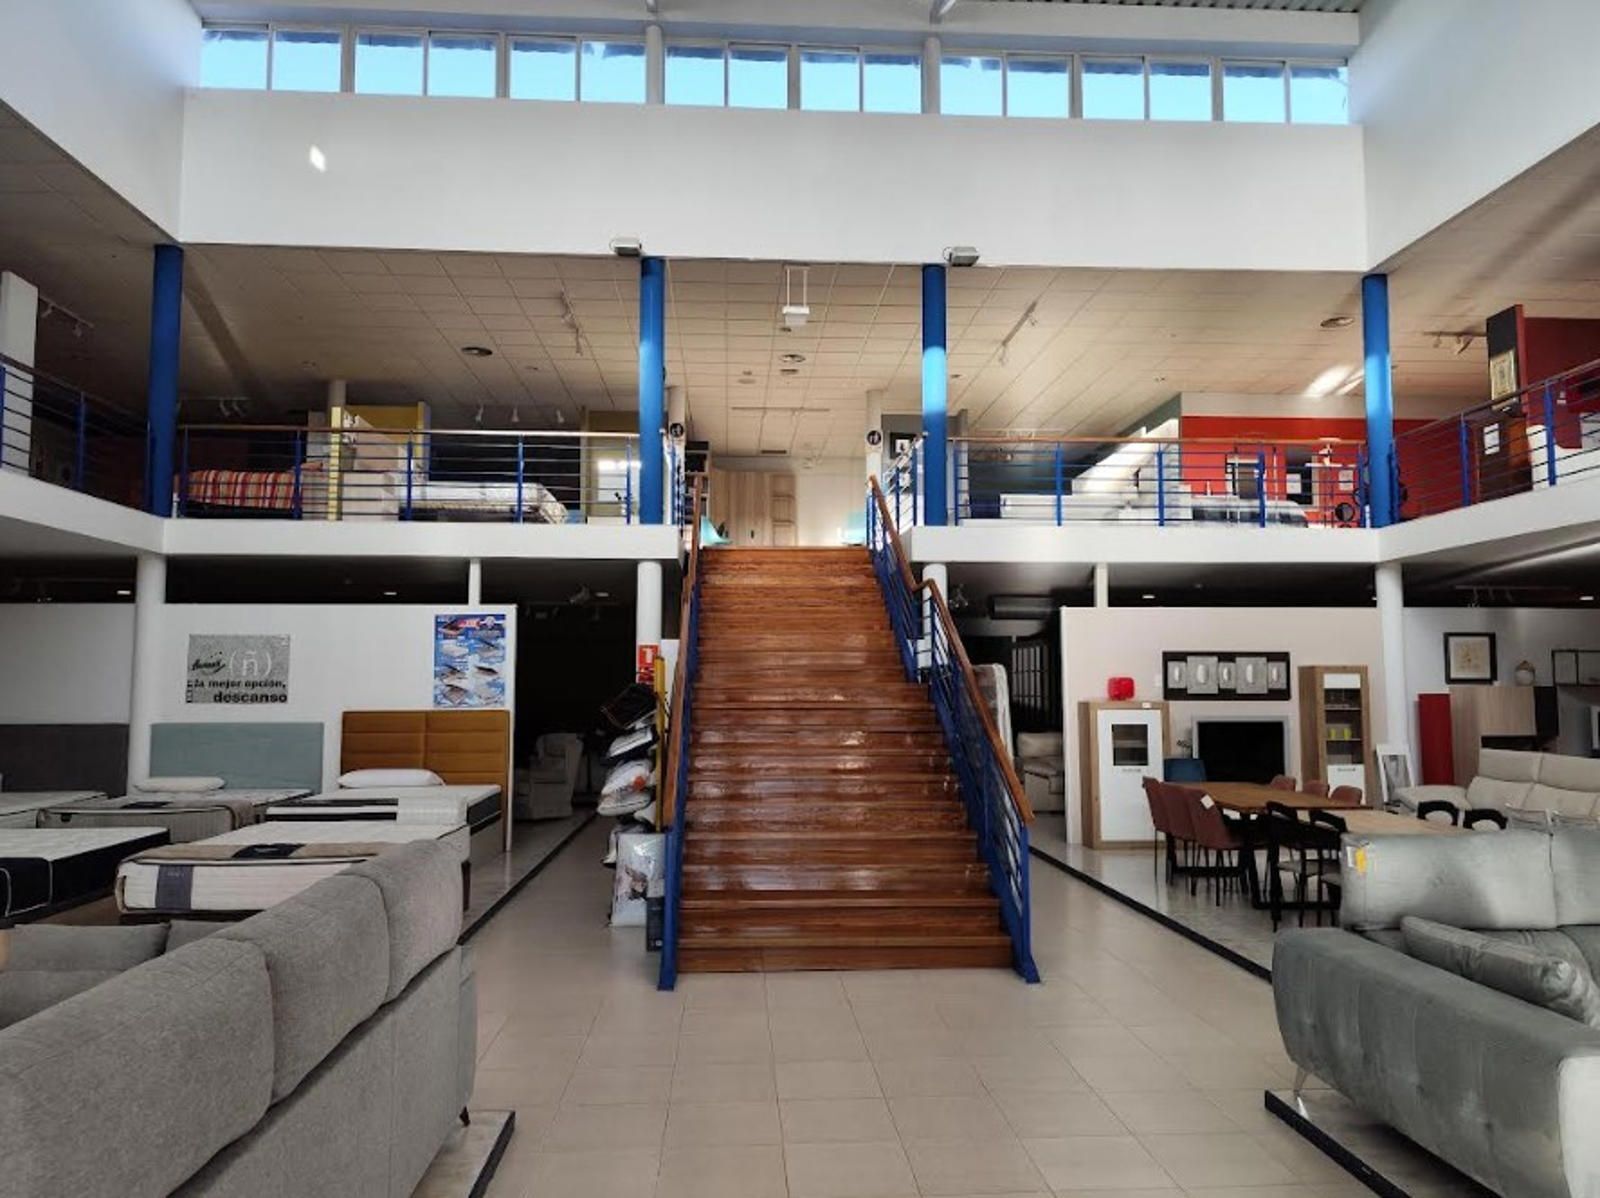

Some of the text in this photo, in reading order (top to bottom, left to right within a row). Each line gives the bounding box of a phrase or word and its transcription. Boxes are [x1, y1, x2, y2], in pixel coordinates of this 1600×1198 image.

[208, 680, 241, 689] mejor
[244, 679, 286, 689] opción,
[213, 691, 287, 703] descanso
